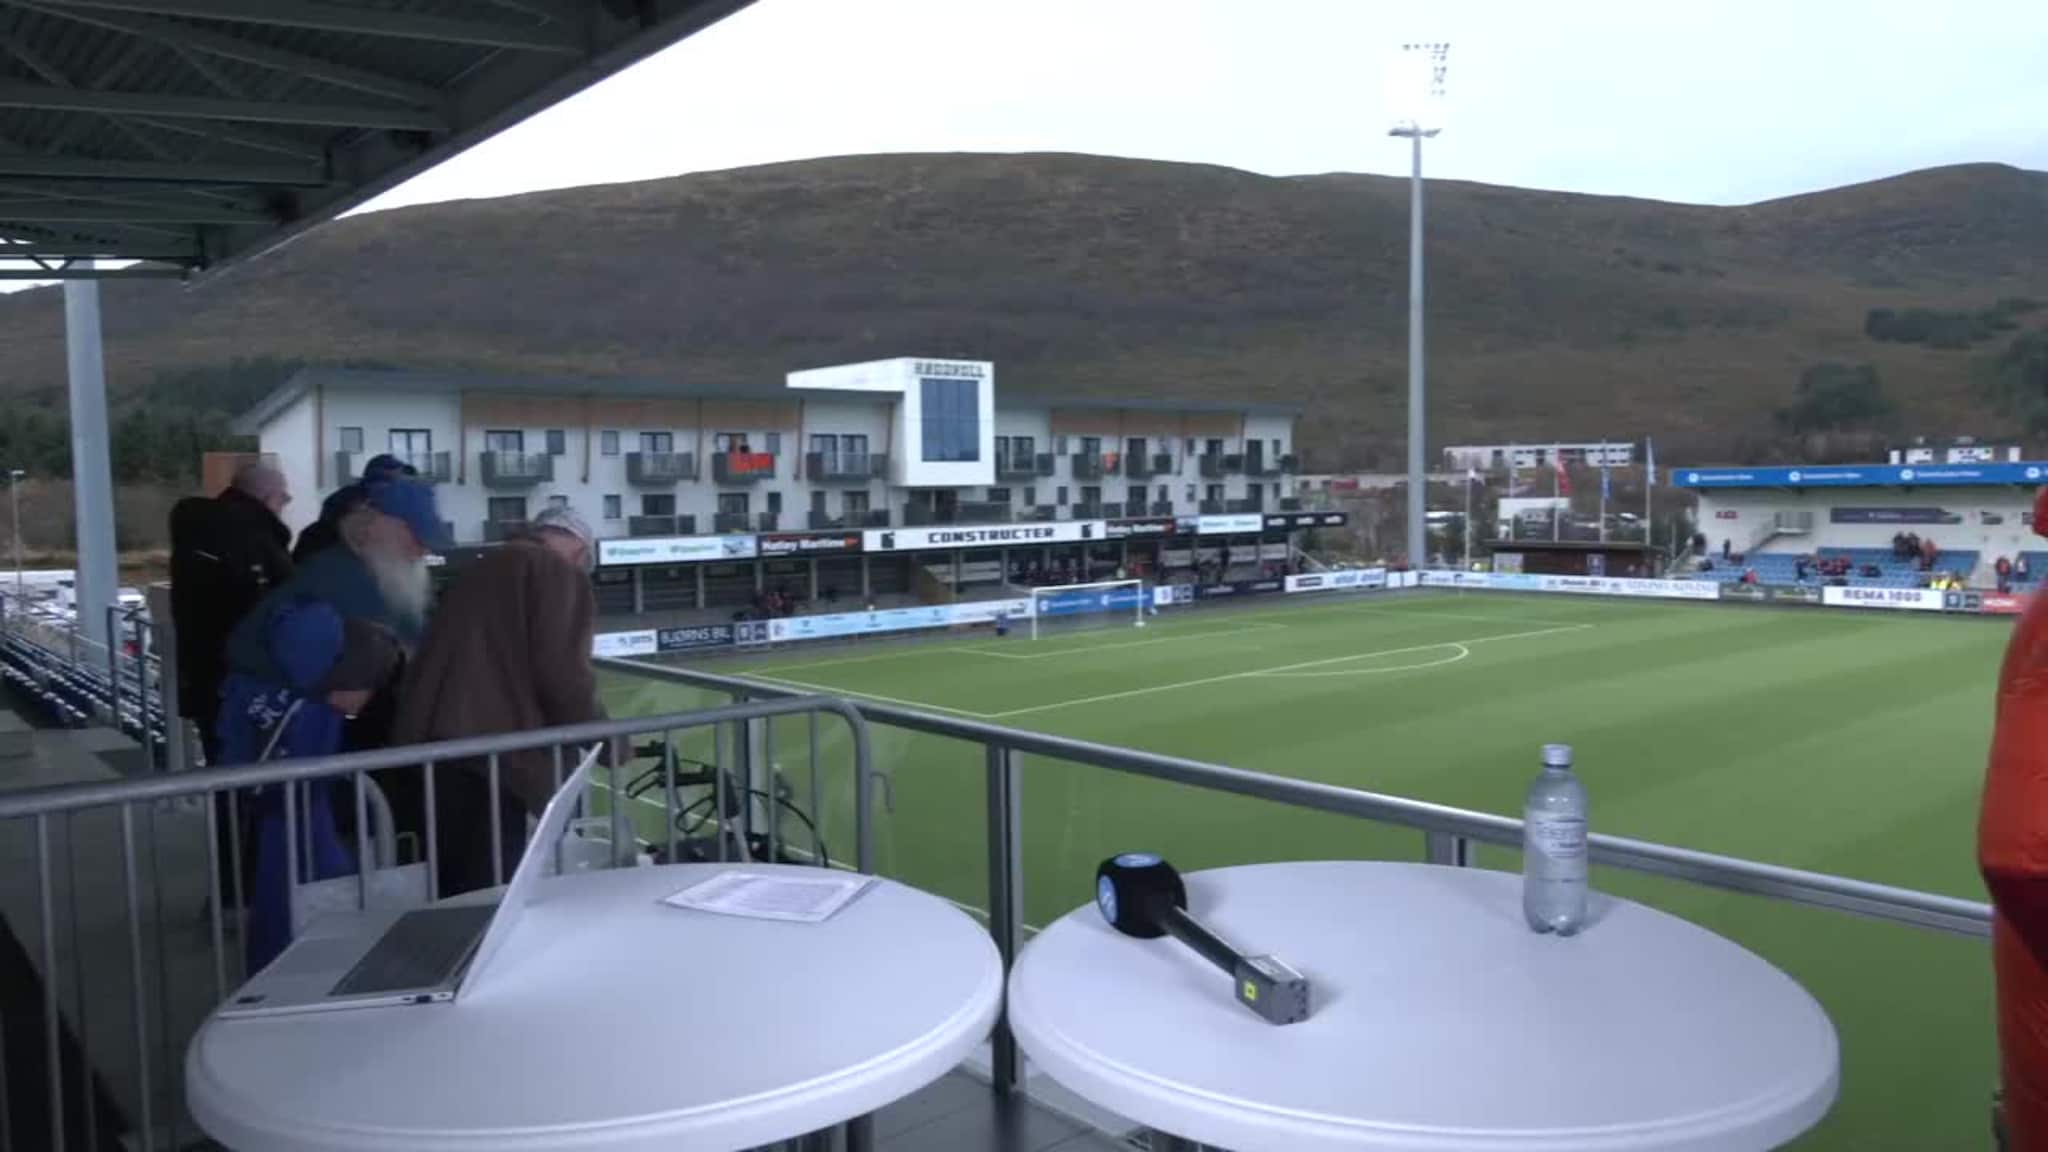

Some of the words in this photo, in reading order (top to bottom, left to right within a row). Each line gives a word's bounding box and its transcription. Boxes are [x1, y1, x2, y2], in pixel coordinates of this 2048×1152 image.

[928, 527, 1055, 544] CONSTRUCTER
[1843, 589, 1885, 601] REMA
[1888, 591, 1922, 602] 1000
